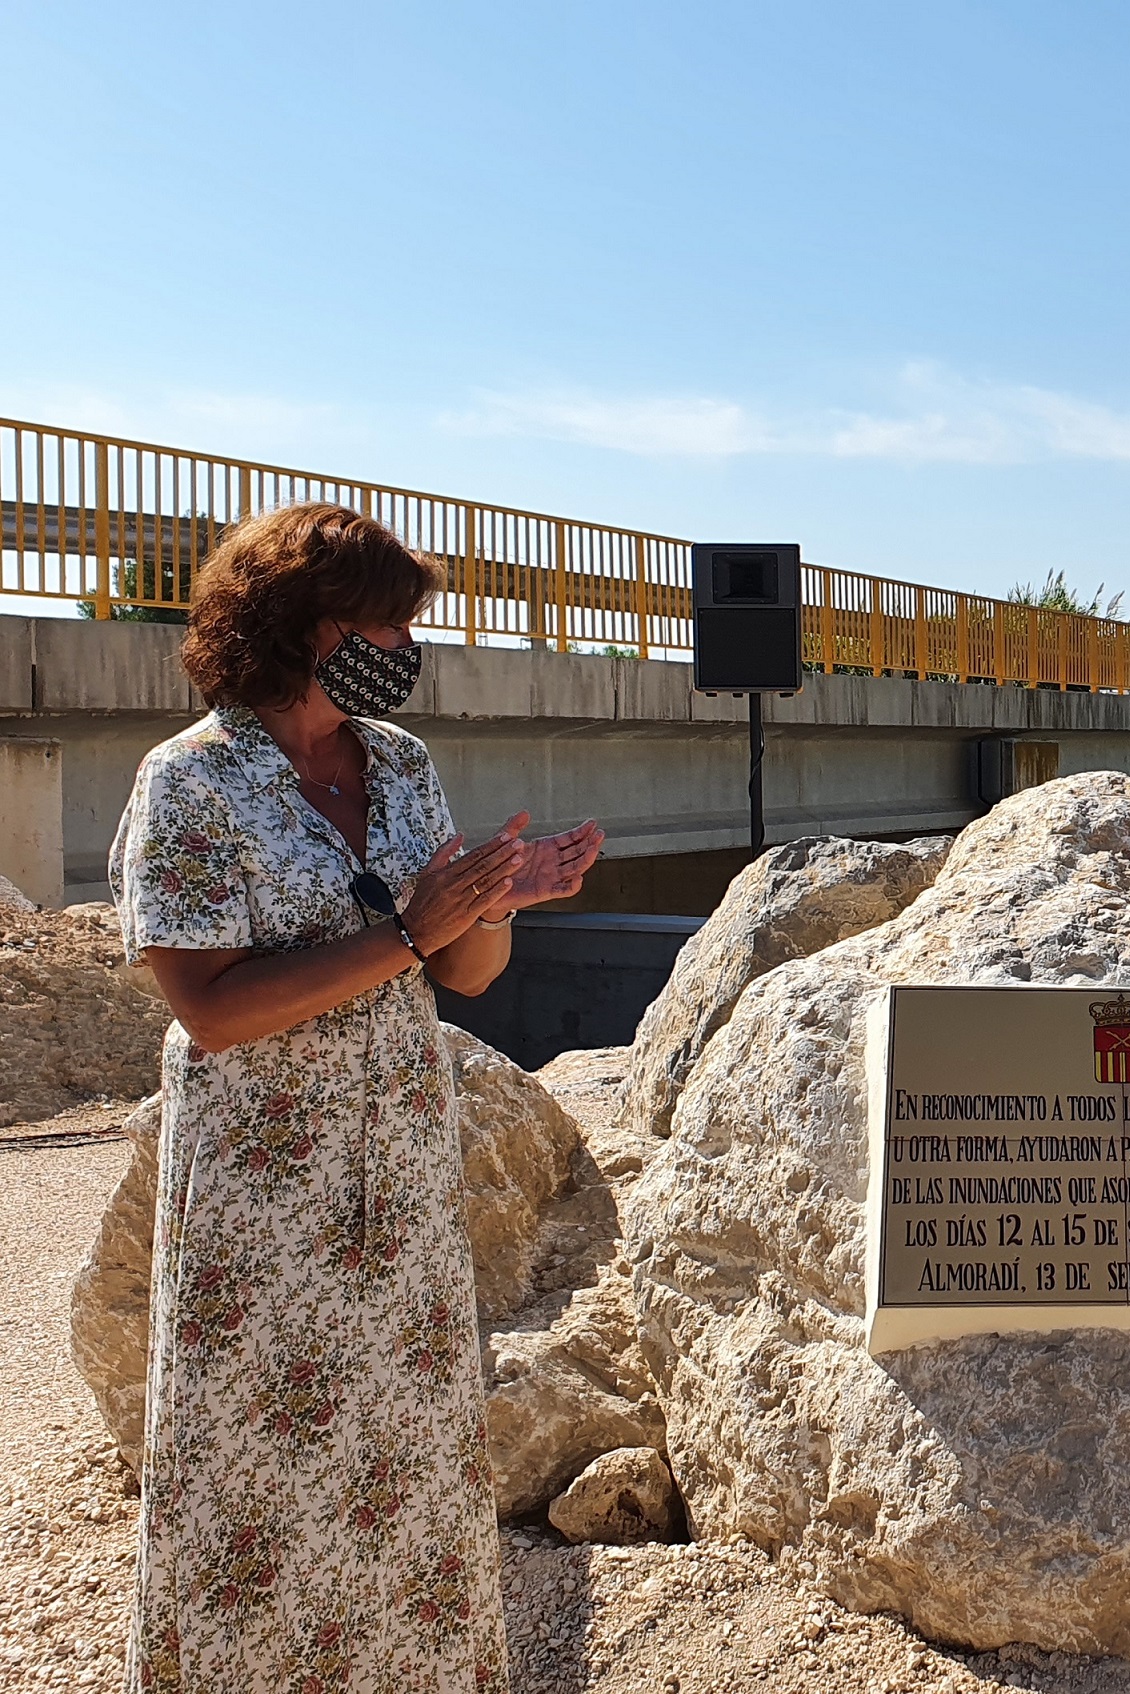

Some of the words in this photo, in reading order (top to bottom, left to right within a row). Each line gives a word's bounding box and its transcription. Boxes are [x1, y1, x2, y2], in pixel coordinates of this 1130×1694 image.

[921, 1094, 1046, 1121] RECONOCIMIENTO
[1051, 1095, 1063, 1121] A
[1067, 1095, 1116, 1122] TODOS
[893, 1136, 904, 1162] U
[909, 1135, 951, 1162] OTRA
[956, 1135, 1014, 1164] FORMA,
[1016, 1135, 1102, 1162] AYUDARON
[1106, 1136, 1120, 1162] A
[892, 1178, 911, 1204] DE
[916, 1177, 944, 1204] LAS
[949, 1176, 1062, 1204] INUNDACIONES
[1068, 1178, 1096, 1206] QUE
[905, 1219, 937, 1247] LOS
[946, 1214, 987, 1247] DÍAS
[996, 1214, 1023, 1246] 12
[1031, 1219, 1055, 1246] AL
[1062, 1213, 1087, 1246] 15
[1093, 1220, 1118, 1246] DE
[1036, 1263, 1055, 1291] 13
[1065, 1263, 1091, 1291] DE
